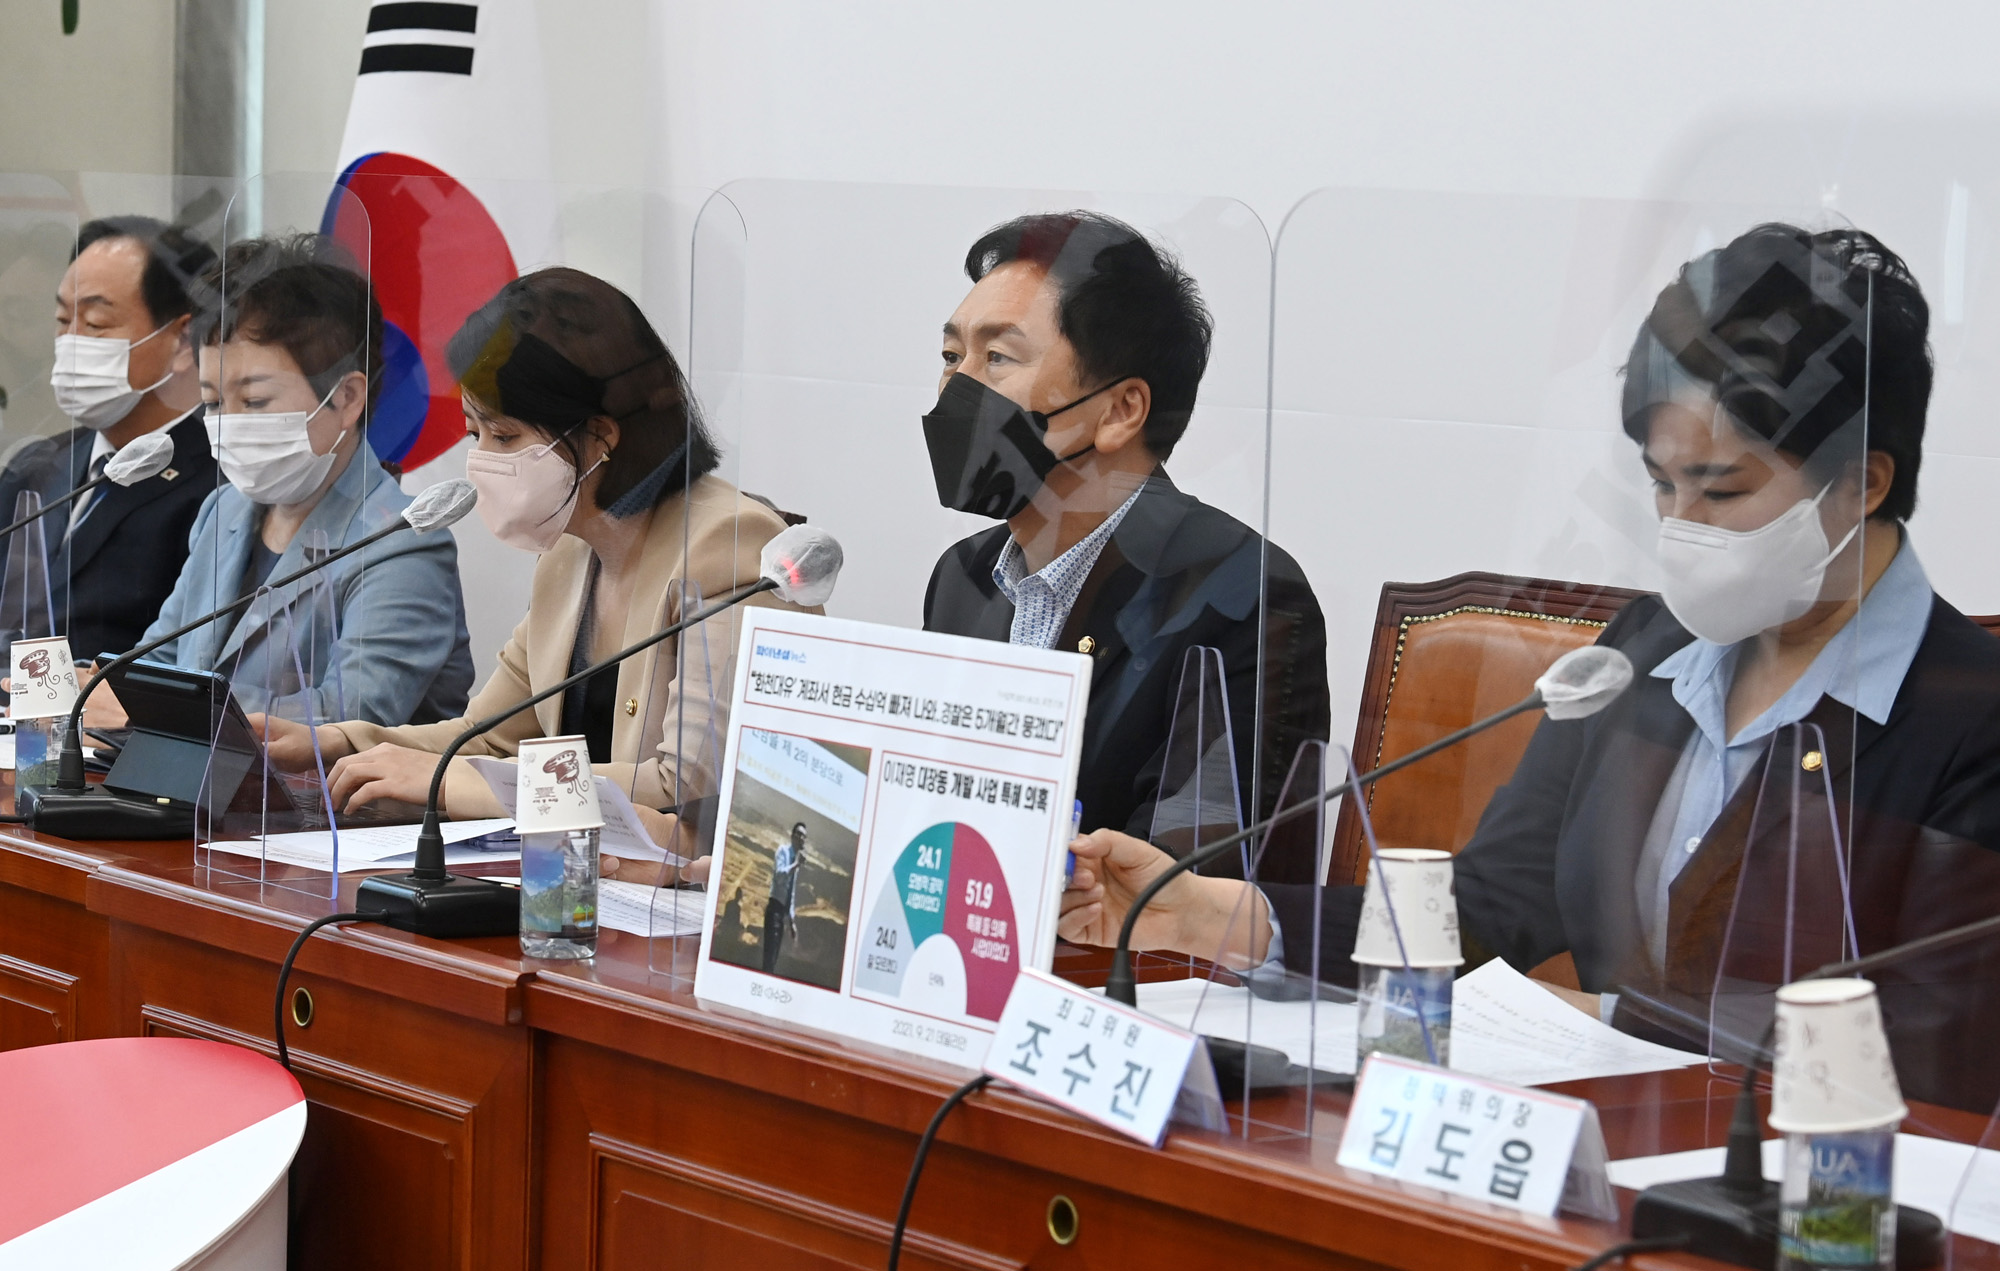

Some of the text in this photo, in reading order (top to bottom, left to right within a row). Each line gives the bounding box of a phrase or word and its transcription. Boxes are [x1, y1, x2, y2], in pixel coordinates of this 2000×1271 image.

[797, 679, 830, 704] 계좌서
[832, 684, 852, 708] 현금
[855, 688, 887, 714] 수십억
[975, 708, 1019, 736] 5개월간
[917, 766, 948, 795] 대장동
[950, 772, 974, 800] 개발
[975, 777, 998, 804] 사업
[1001, 781, 1022, 809] 특혜
[1024, 786, 1049, 814] 의혹
[916, 844, 942, 870] 24.1
[965, 879, 994, 909] 51.9
[876, 926, 897, 950] 24.0
[1056, 998, 1142, 1048] 최고위원
[1009, 1020, 1152, 1121] 조수진
[1369, 1106, 1533, 1201] 김도읍
